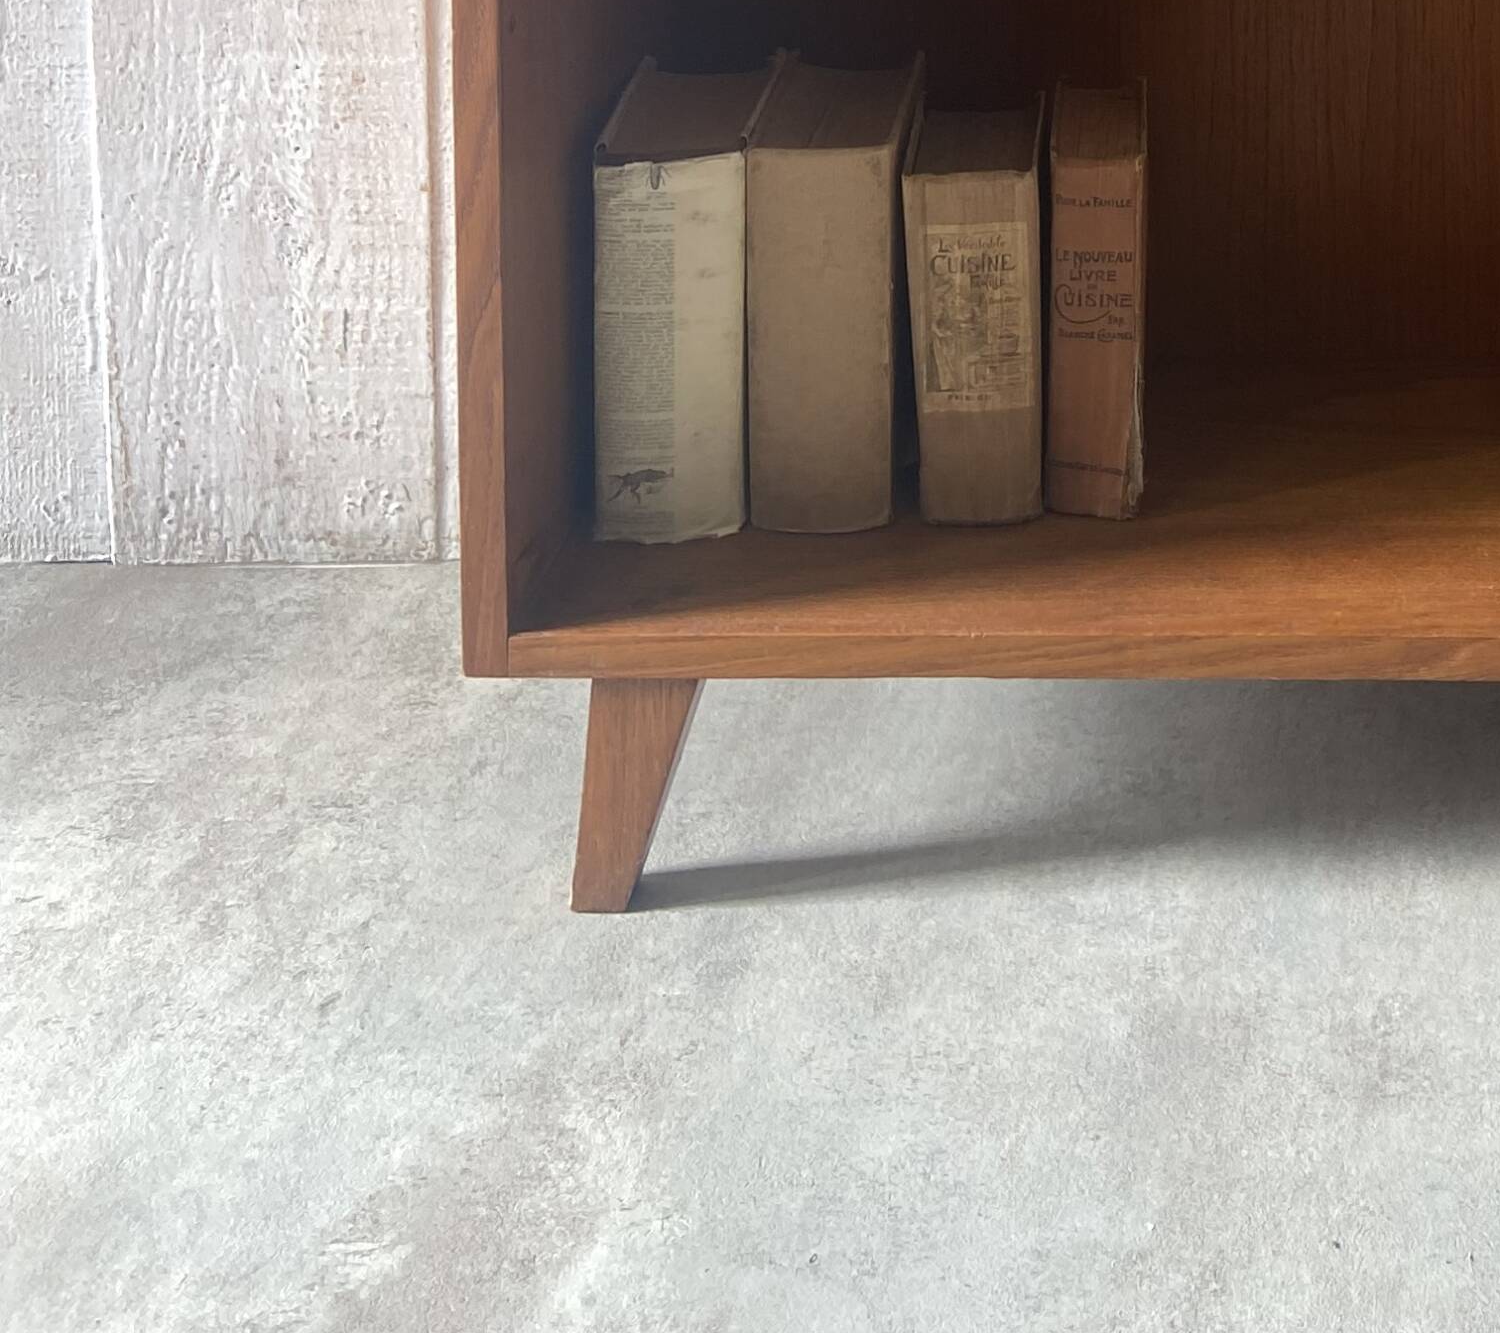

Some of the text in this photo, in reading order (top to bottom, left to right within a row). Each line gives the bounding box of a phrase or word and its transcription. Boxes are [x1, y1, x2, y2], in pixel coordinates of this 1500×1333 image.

[930, 252, 1016, 277] CUISINE
[1055, 248, 1133, 269] LE NOUVEAU
[1069, 269, 1118, 282] LIVRE
[1054, 284, 1134, 324] CUISINE
